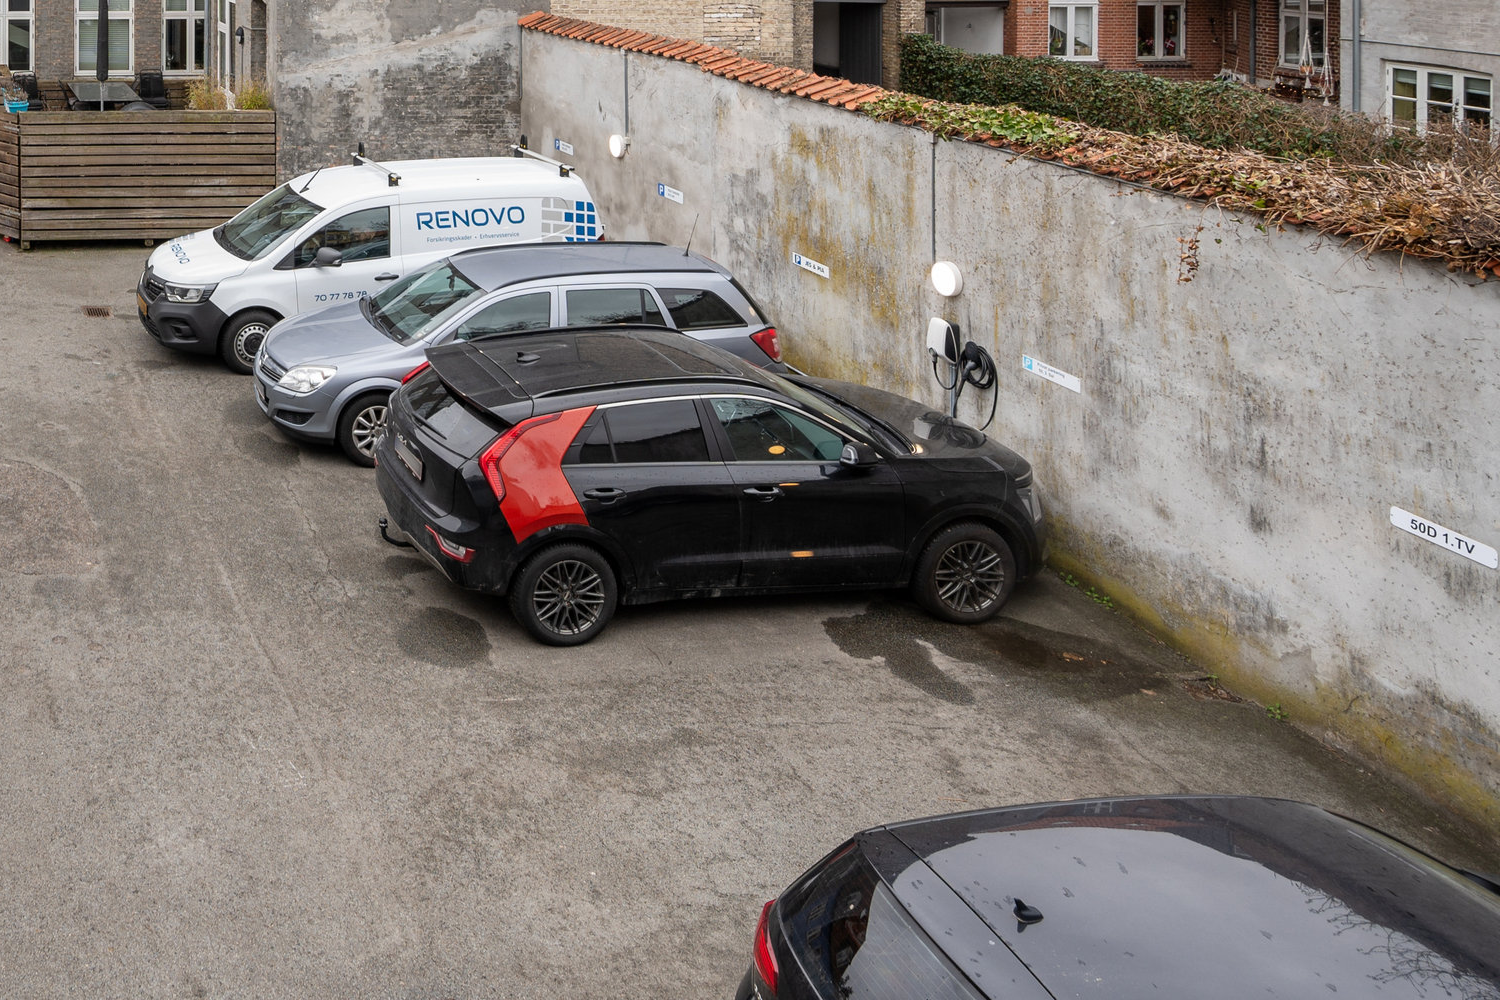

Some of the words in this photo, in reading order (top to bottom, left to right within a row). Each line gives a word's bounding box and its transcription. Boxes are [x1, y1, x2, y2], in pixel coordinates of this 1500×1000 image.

[416, 206, 525, 230] RENOVO
[426, 234, 472, 243] Forsikringsskader
[479, 231, 520, 240] Erhvervsservice
[314, 294, 328, 302] 70
[1410, 518, 1437, 538] 50D
[1442, 533, 1475, 554] 1.TV
